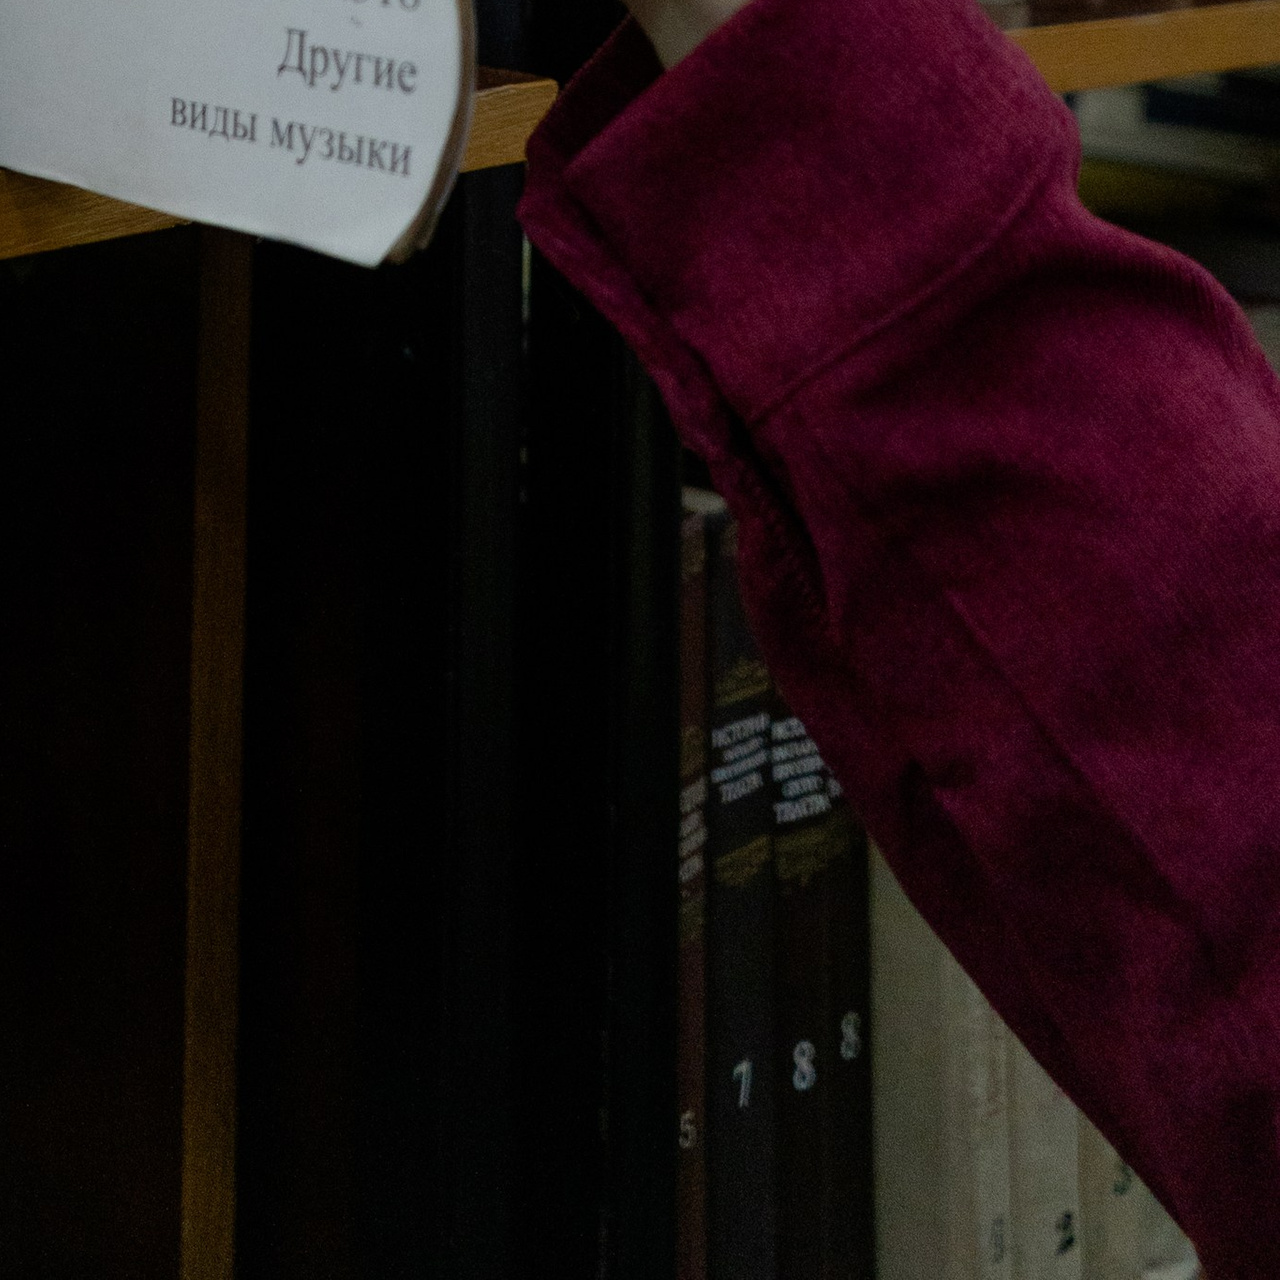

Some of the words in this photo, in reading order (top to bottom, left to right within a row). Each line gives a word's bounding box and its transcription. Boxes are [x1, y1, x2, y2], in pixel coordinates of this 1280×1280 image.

[276, 26, 418, 95] Другие
[170, 96, 258, 142] виды
[270, 116, 413, 177] музыки
[792, 1040, 818, 1091] 8
